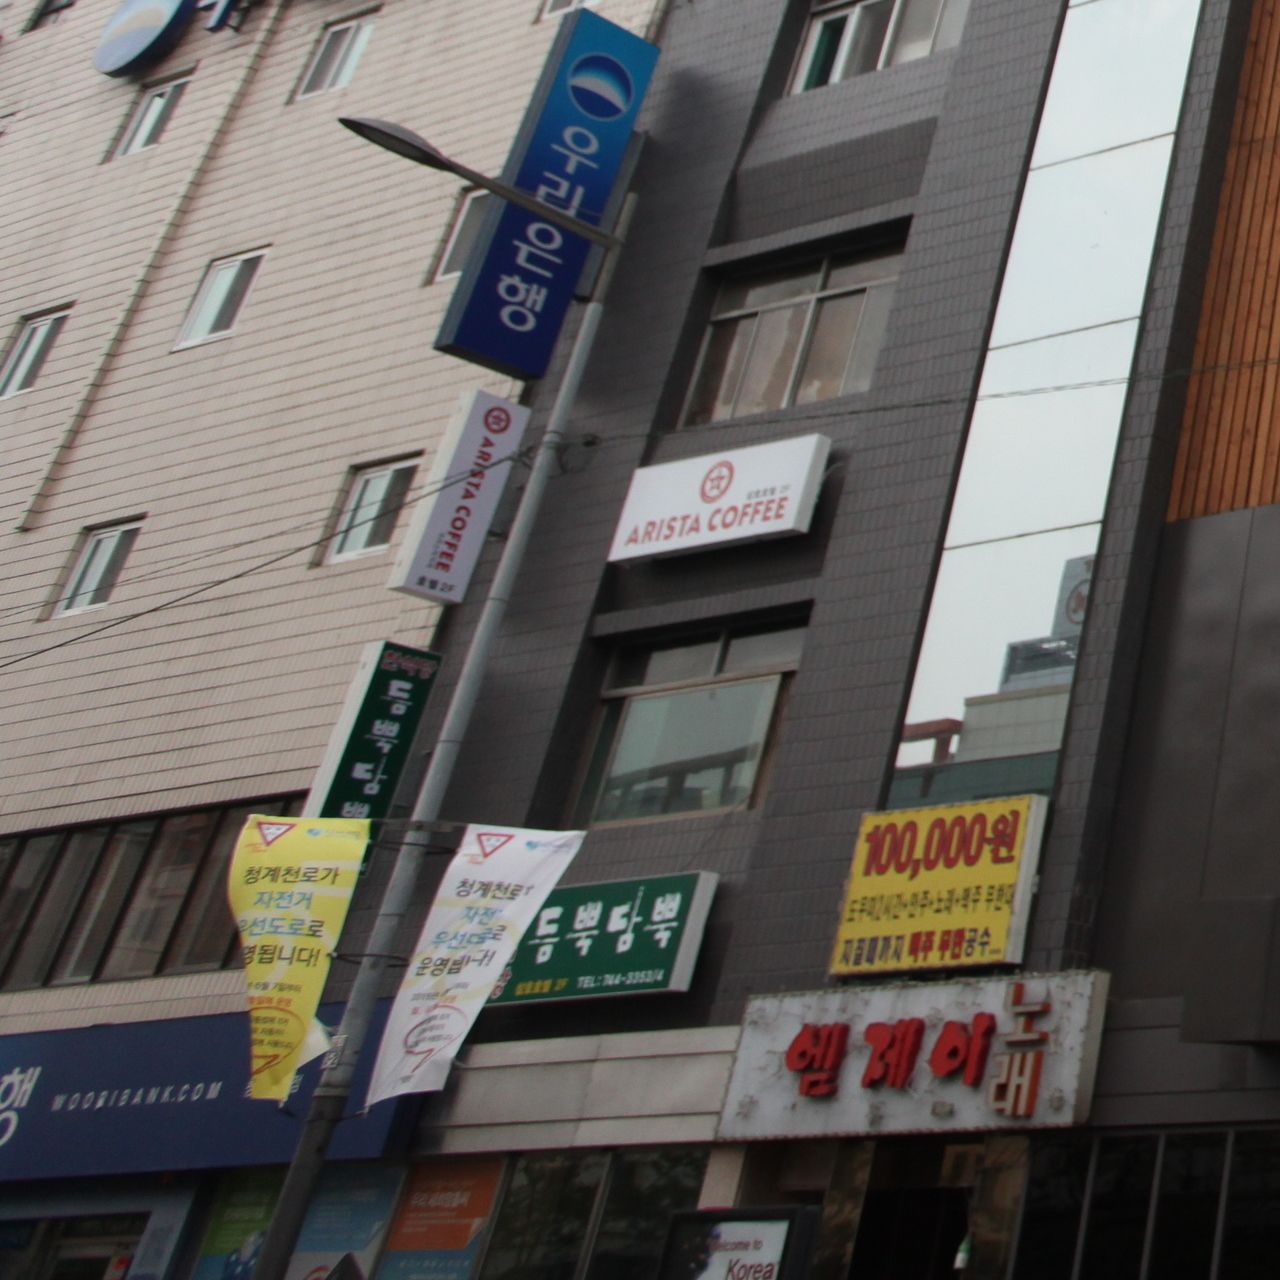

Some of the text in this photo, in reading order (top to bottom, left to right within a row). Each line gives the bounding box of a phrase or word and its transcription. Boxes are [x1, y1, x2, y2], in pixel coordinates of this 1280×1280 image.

[498, 123, 600, 333] 우리은행
[461, 436, 495, 500] ARISTA
[436, 505, 471, 572] COFFEE
[625, 496, 789, 546] ARISTA COFFEE
[863, 809, 1021, 881] 100,000원
[244, 865, 339, 885] 청계천로가
[253, 890, 314, 910] 자전거
[528, 886, 682, 964] 듬뿍담뿍
[988, 982, 1052, 1119] 노래
[51, 1081, 222, 1112] WOORIBANK.COM
[724, 1257, 778, 1280] Korea
[752, 1238, 764, 1251] to
